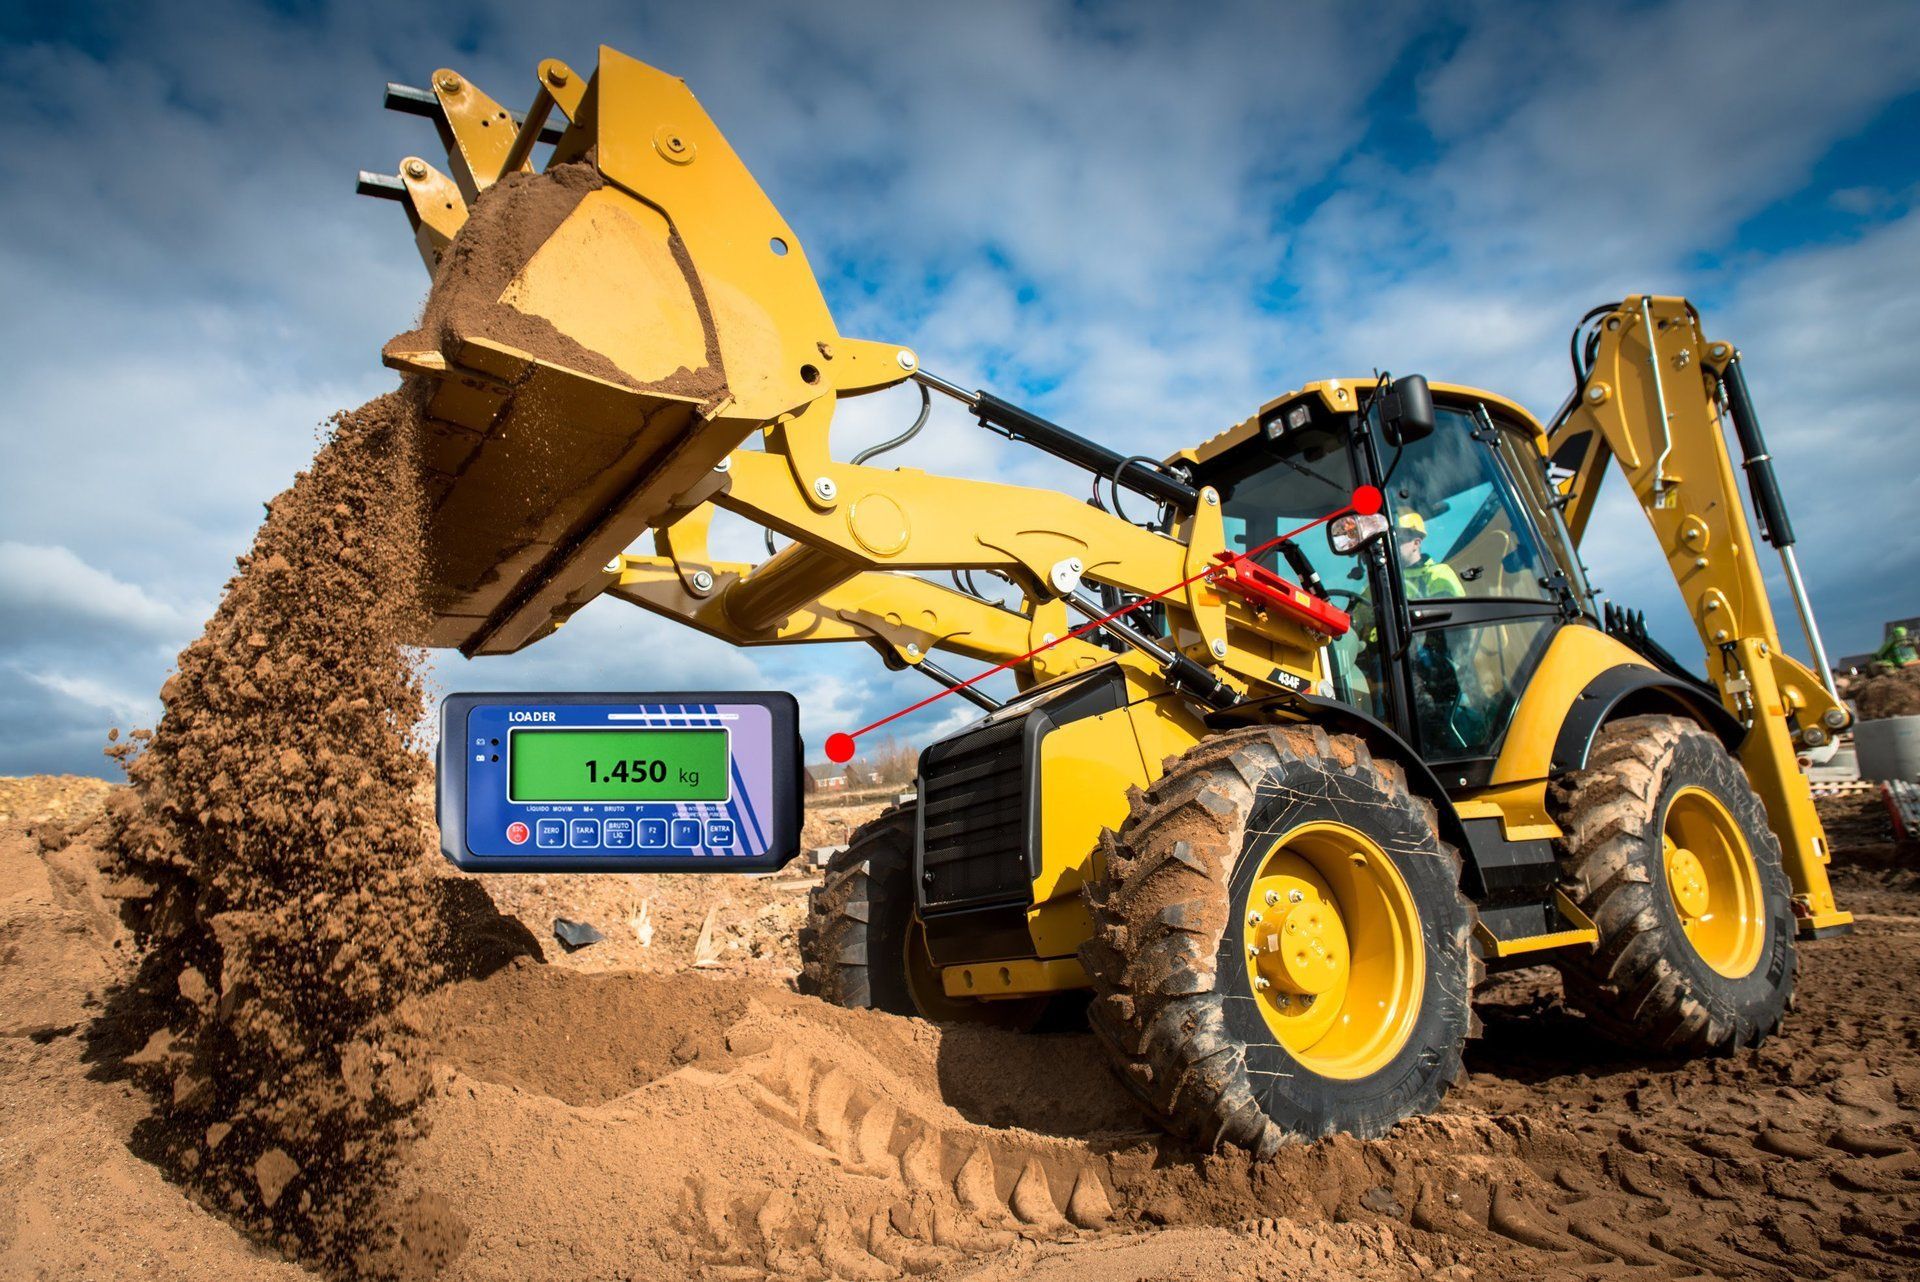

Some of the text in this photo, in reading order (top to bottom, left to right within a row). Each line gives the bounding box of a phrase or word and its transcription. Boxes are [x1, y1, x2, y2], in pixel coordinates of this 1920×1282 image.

[1278, 672, 1300, 689] 434F
[509, 711, 556, 722] LOADER
[585, 759, 699, 787] 1.450 kg
[710, 825, 730, 833] ENTRA
